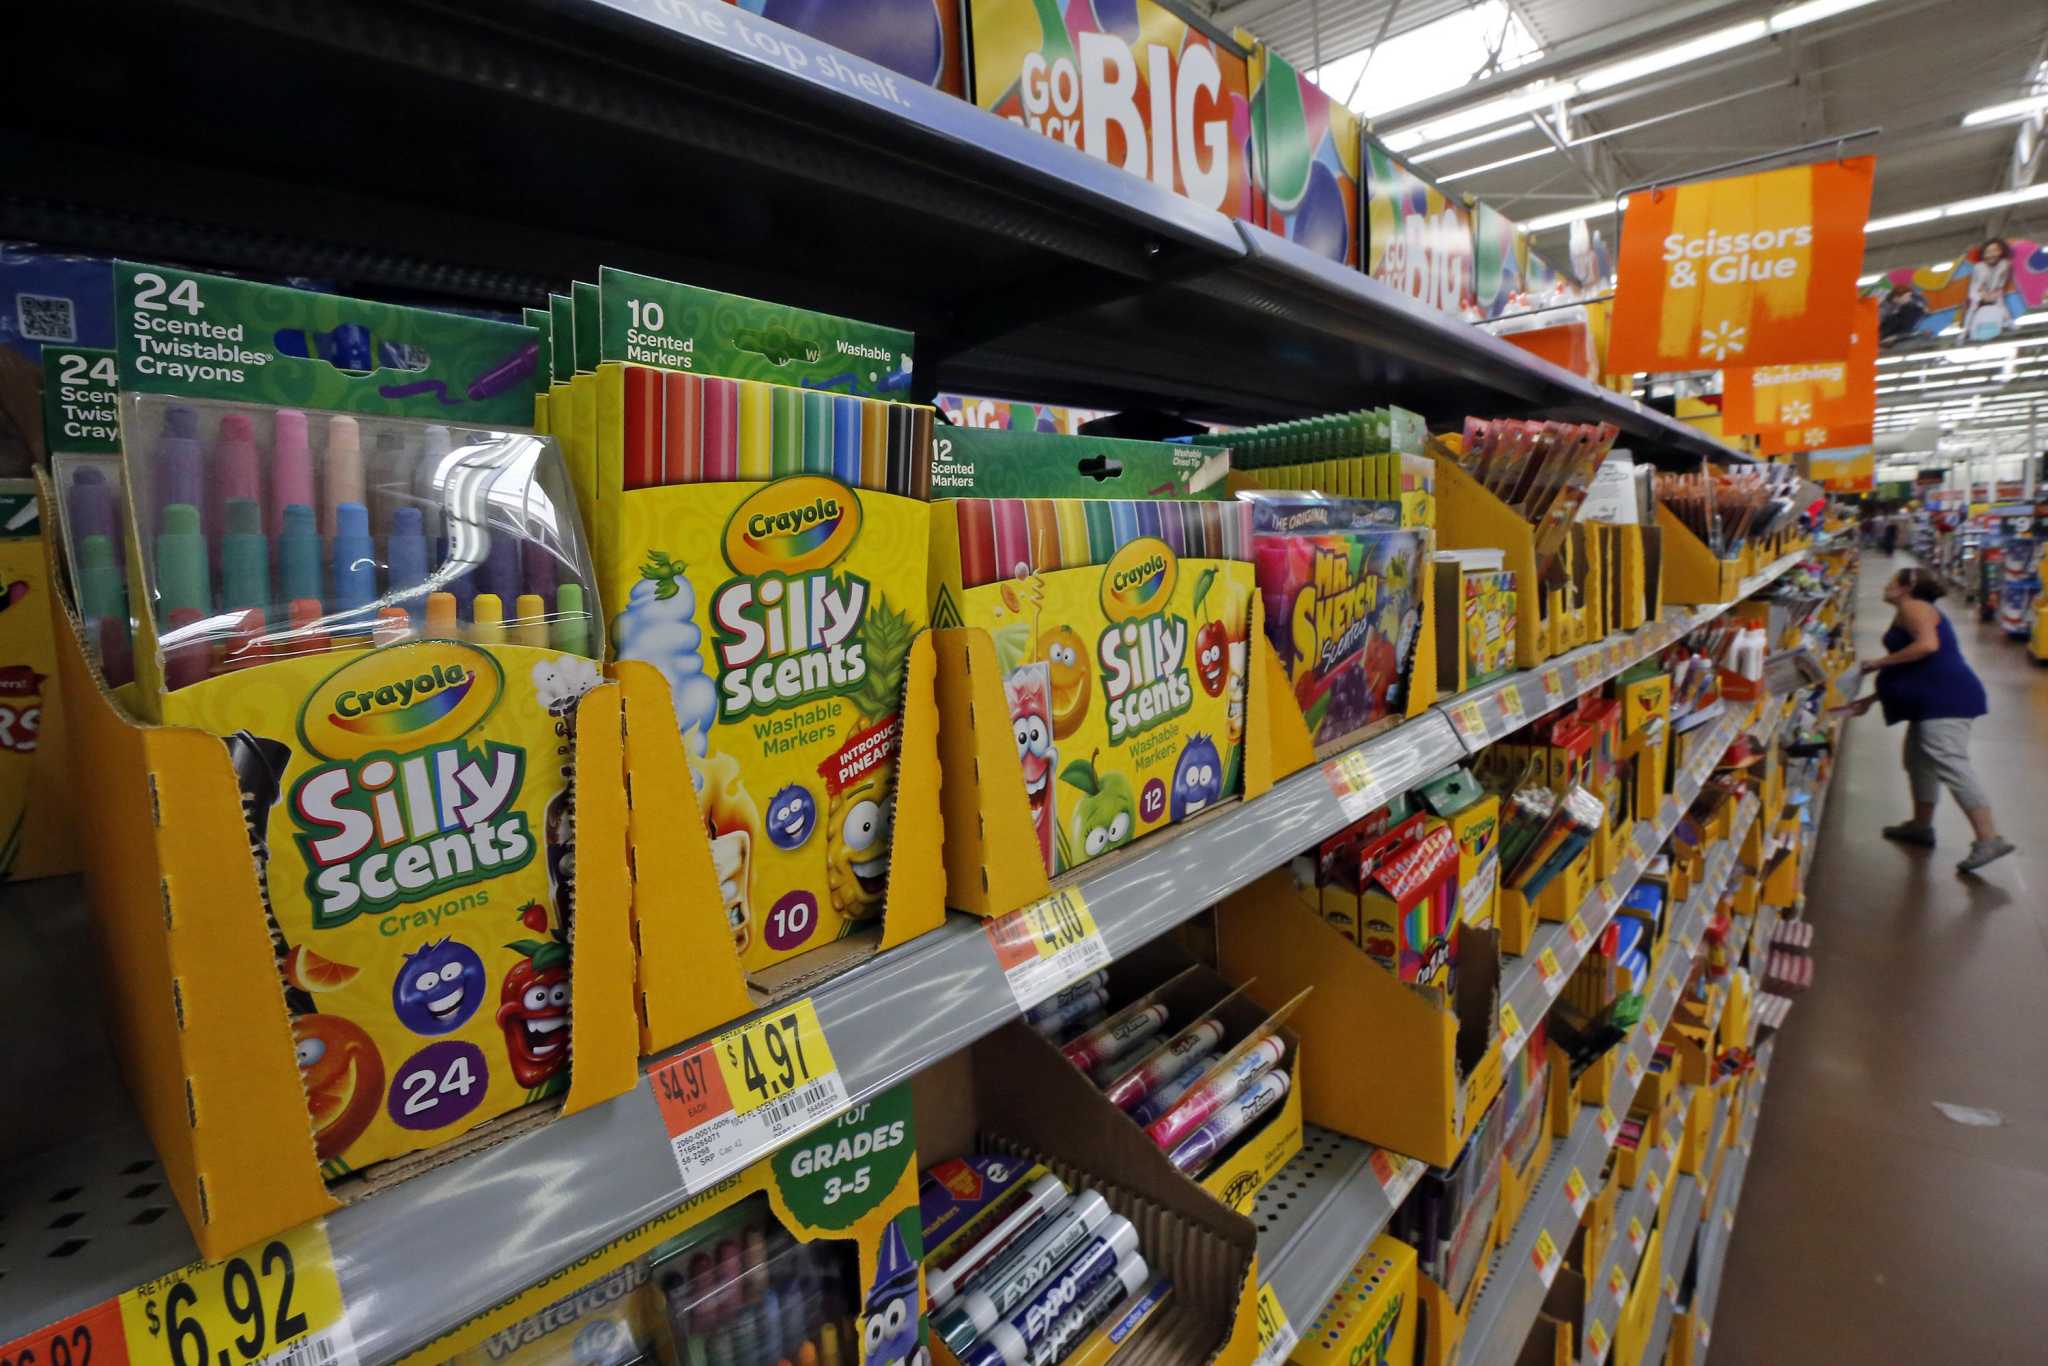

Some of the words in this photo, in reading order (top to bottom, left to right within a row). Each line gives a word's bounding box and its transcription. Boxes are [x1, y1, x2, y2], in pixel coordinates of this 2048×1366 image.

[736, 20, 808, 69] top
[816, 54, 911, 108] shelf.
[1022, 53, 1079, 117] GO
[1079, 32, 1228, 211] BIG
[1662, 225, 1812, 261] Scissors
[1670, 262, 1696, 288] &
[1707, 253, 1798, 283] Glue
[133, 273, 205, 316] 24
[133, 311, 244, 342] Scented
[627, 299, 664, 331] 10
[627, 329, 693, 353] Scented
[627, 345, 692, 368] Markers
[836, 340, 891, 362] Washable
[58, 354, 119, 387] 24
[135, 356, 245, 383] Crayons
[931, 462, 974, 474] Scented
[932, 439, 953, 461] 12
[932, 475, 974, 487] Markers
[748, 498, 838, 538] Crayola
[1272, 514, 1288, 530] THE
[1289, 508, 1328, 529] ORIGINAL
[1113, 555, 1164, 591] Crayola
[716, 575, 865, 668] Silly
[1101, 617, 1184, 697] Silly
[335, 665, 465, 717] Crayola
[753, 702, 842, 741] Washable
[763, 723, 836, 758] Markers
[1129, 724, 1180, 757] Washable
[1135, 743, 1177, 773] Markers
[298, 748, 518, 865] Silly
[1144, 787, 1162, 812] 12
[379, 891, 489, 937] Crayons
[774, 902, 809, 938] 10
[727, 1013, 808, 1099] $4.97
[402, 1056, 476, 1116] 24
[659, 1055, 708, 1104] $4.97
[790, 1120, 905, 1178] GRADES
[822, 1167, 872, 1205] 3-5
